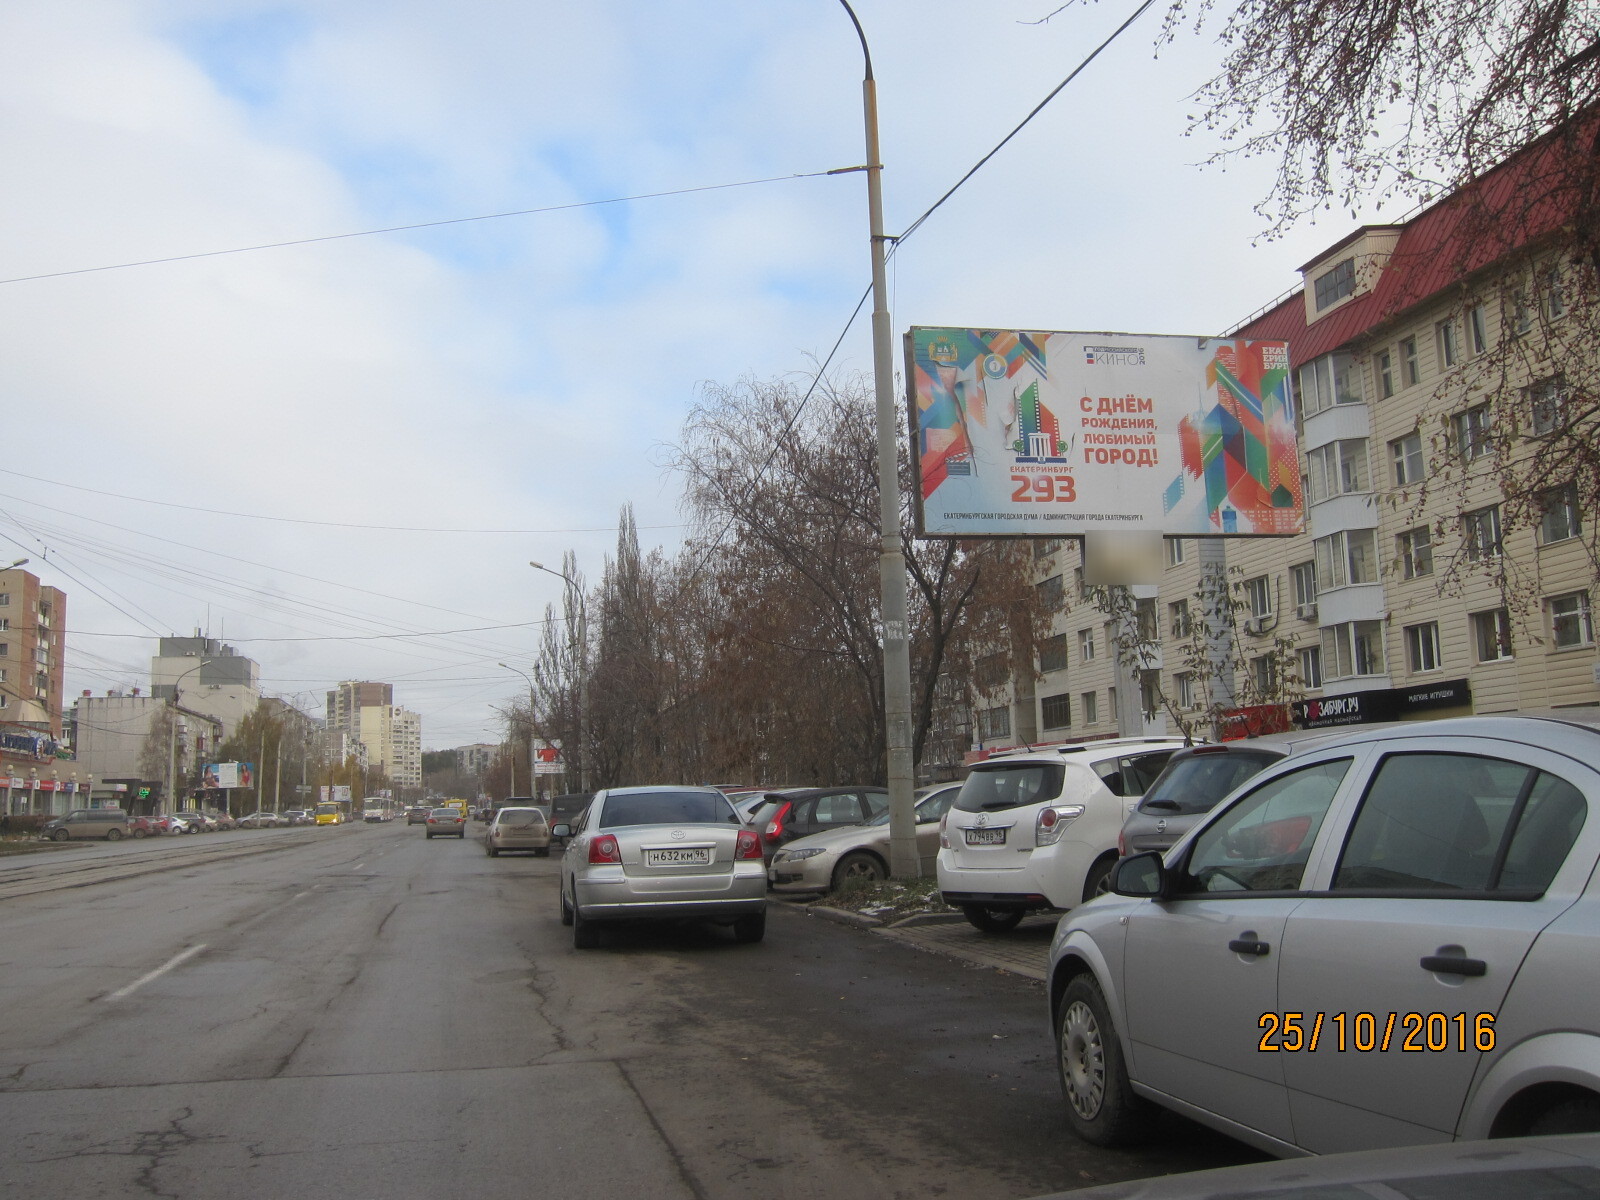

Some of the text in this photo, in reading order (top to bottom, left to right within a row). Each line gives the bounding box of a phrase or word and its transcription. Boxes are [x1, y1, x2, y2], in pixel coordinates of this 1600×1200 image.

[1095, 352, 1139, 366] КИНО
[1138, 347, 1146, 365] 2016
[1080, 394, 1153, 416] С ДНЁМ
[1081, 417, 1158, 431] РОЖДЕНИЯ,
[1083, 431, 1156, 445] ЛЮБИМЫЙ
[1084, 447, 1159, 468] ГОРОД!
[1009, 466, 1074, 474] ЕКАТЕРИНБУРГ
[1011, 475, 1077, 502] 293
[695, 850, 705, 858] 96
